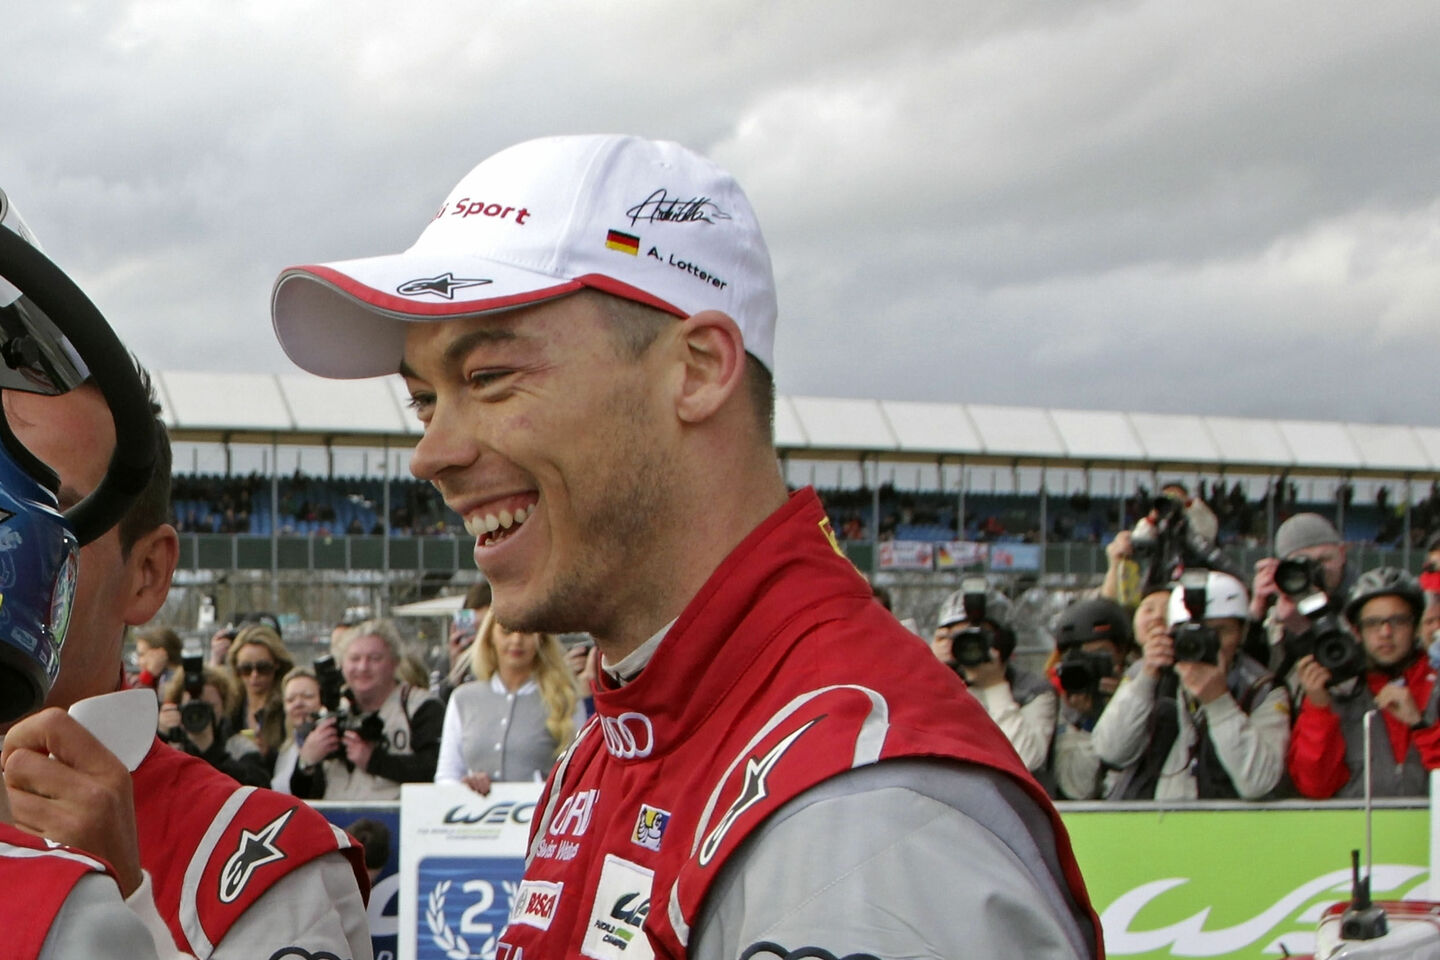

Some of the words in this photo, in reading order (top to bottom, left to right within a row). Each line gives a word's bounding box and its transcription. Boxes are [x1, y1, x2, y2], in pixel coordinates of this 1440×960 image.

[451, 197, 530, 225] Sport
[647, 246, 663, 261] A.
[668, 254, 728, 290] Lotterer
[460, 880, 494, 933] 2
